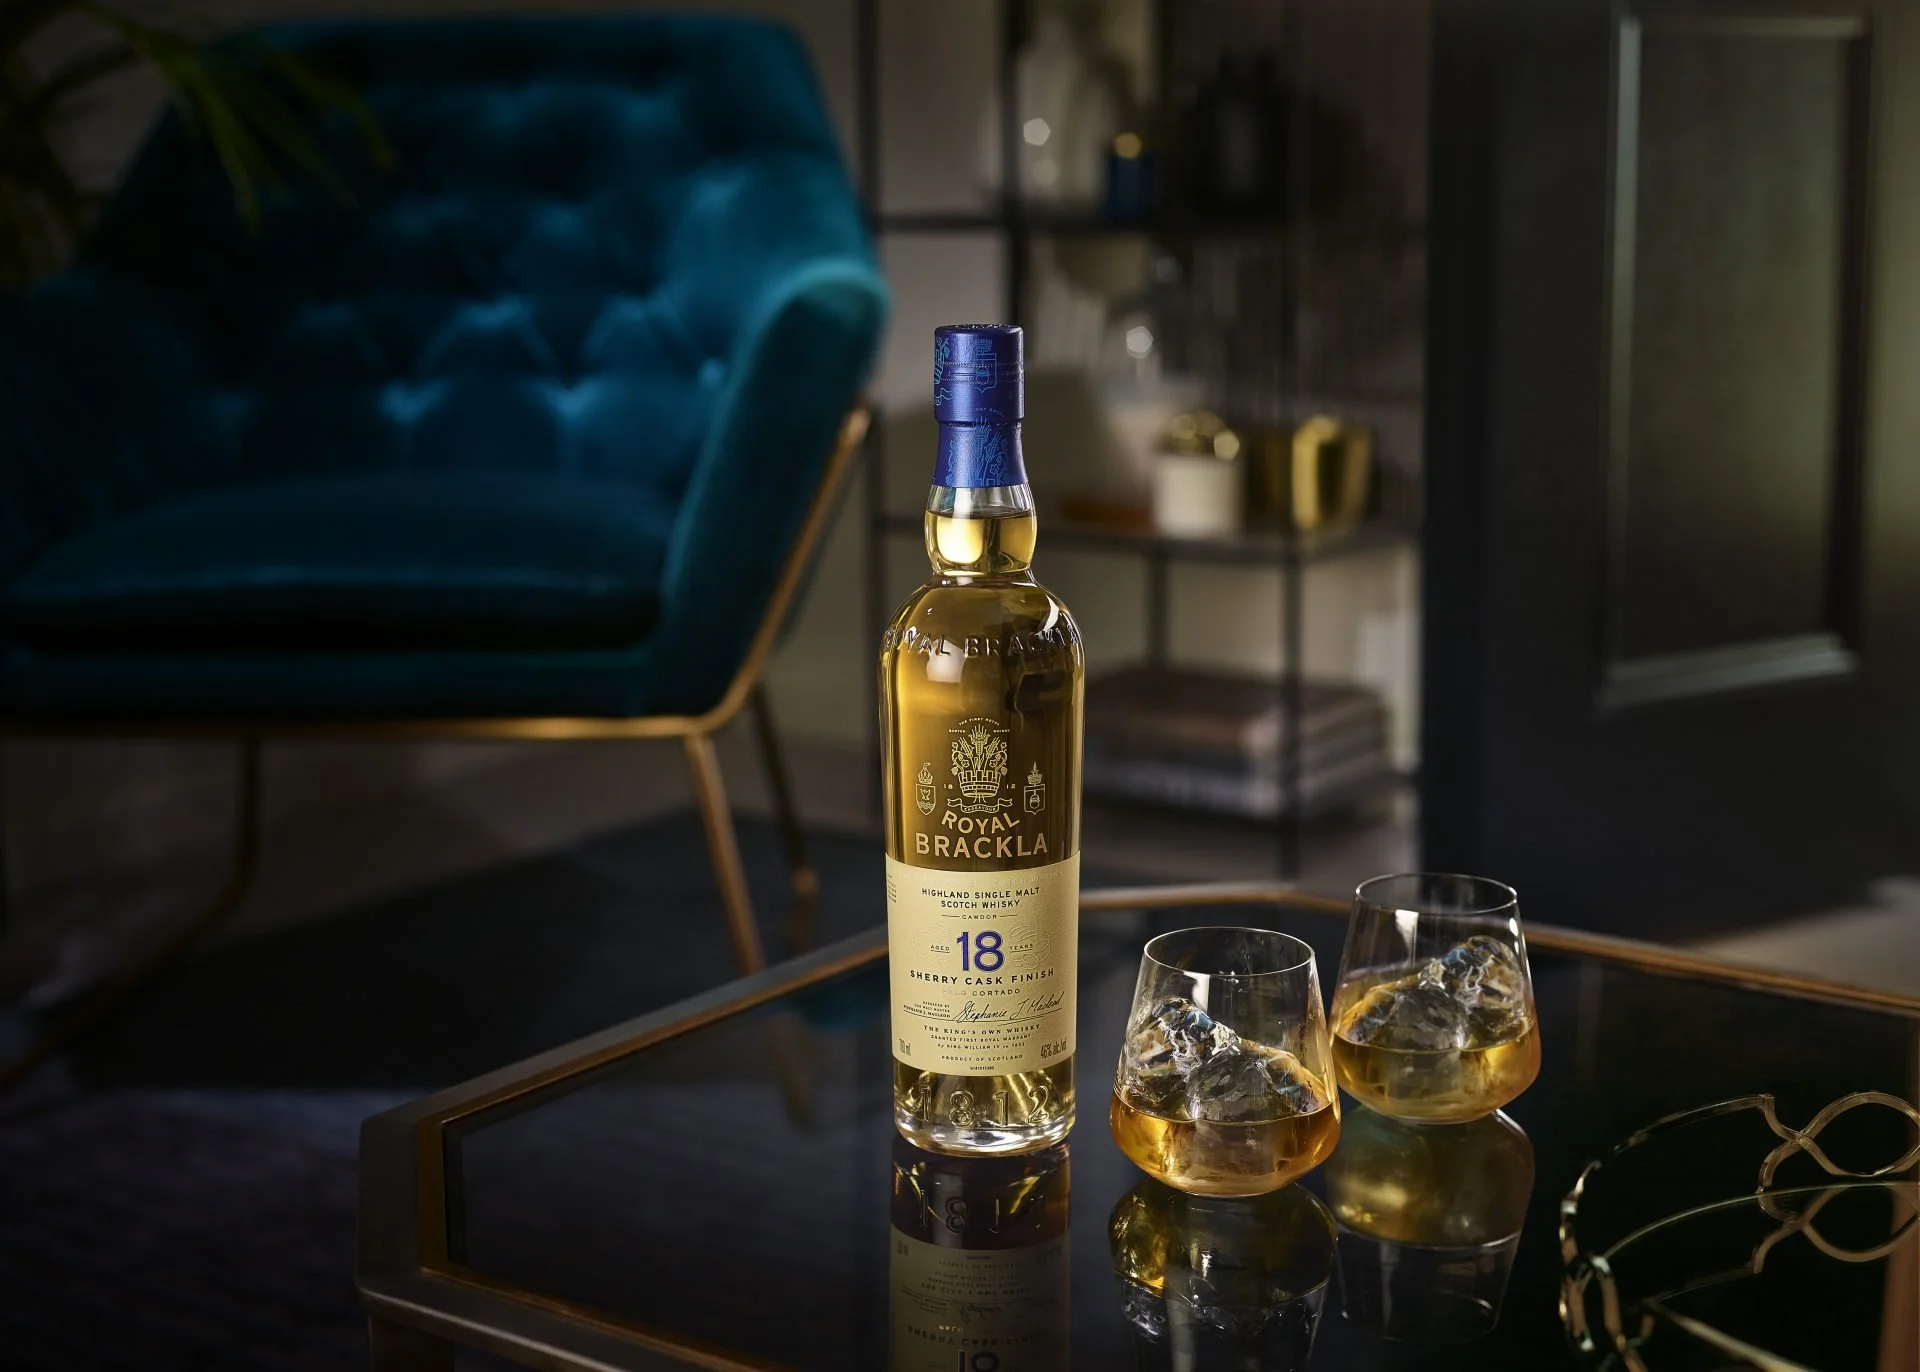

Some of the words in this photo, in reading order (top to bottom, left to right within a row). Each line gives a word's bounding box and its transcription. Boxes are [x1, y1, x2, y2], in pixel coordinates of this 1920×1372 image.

[941, 810, 1020, 835] ROYAL
[915, 832, 1048, 859] BRACKLA
[921, 887, 970, 899] HIGHLAND
[975, 890, 1011, 899] SINGLE
[1015, 886, 1041, 897] MALT
[940, 900, 977, 909] SCOTCH
[982, 899, 1020, 909] WHISKY
[956, 930, 1005, 972] 18
[1009, 943, 1034, 951] YEARS
[910, 969, 958, 985] SHERRY
[964, 977, 1003, 986] CASK
[1012, 968, 1054, 984] FINISH
[972, 988, 1021, 997] CORTADO
[923, 1025, 939, 1033] THE
[943, 1027, 978, 1035] KING'S
[981, 1027, 1002, 1035] OWN
[1006, 1024, 1041, 1034] WHISKY
[930, 1034, 957, 1042] GRANTED
[1002, 1034, 1031, 1042] WARRANT
[941, 1054, 972, 1062] PRODUCT
[988, 1054, 1023, 1062] SCOTLAND
[1040, 1043, 1053, 1060] 46%
[918, 1080, 1050, 1128] 1812
